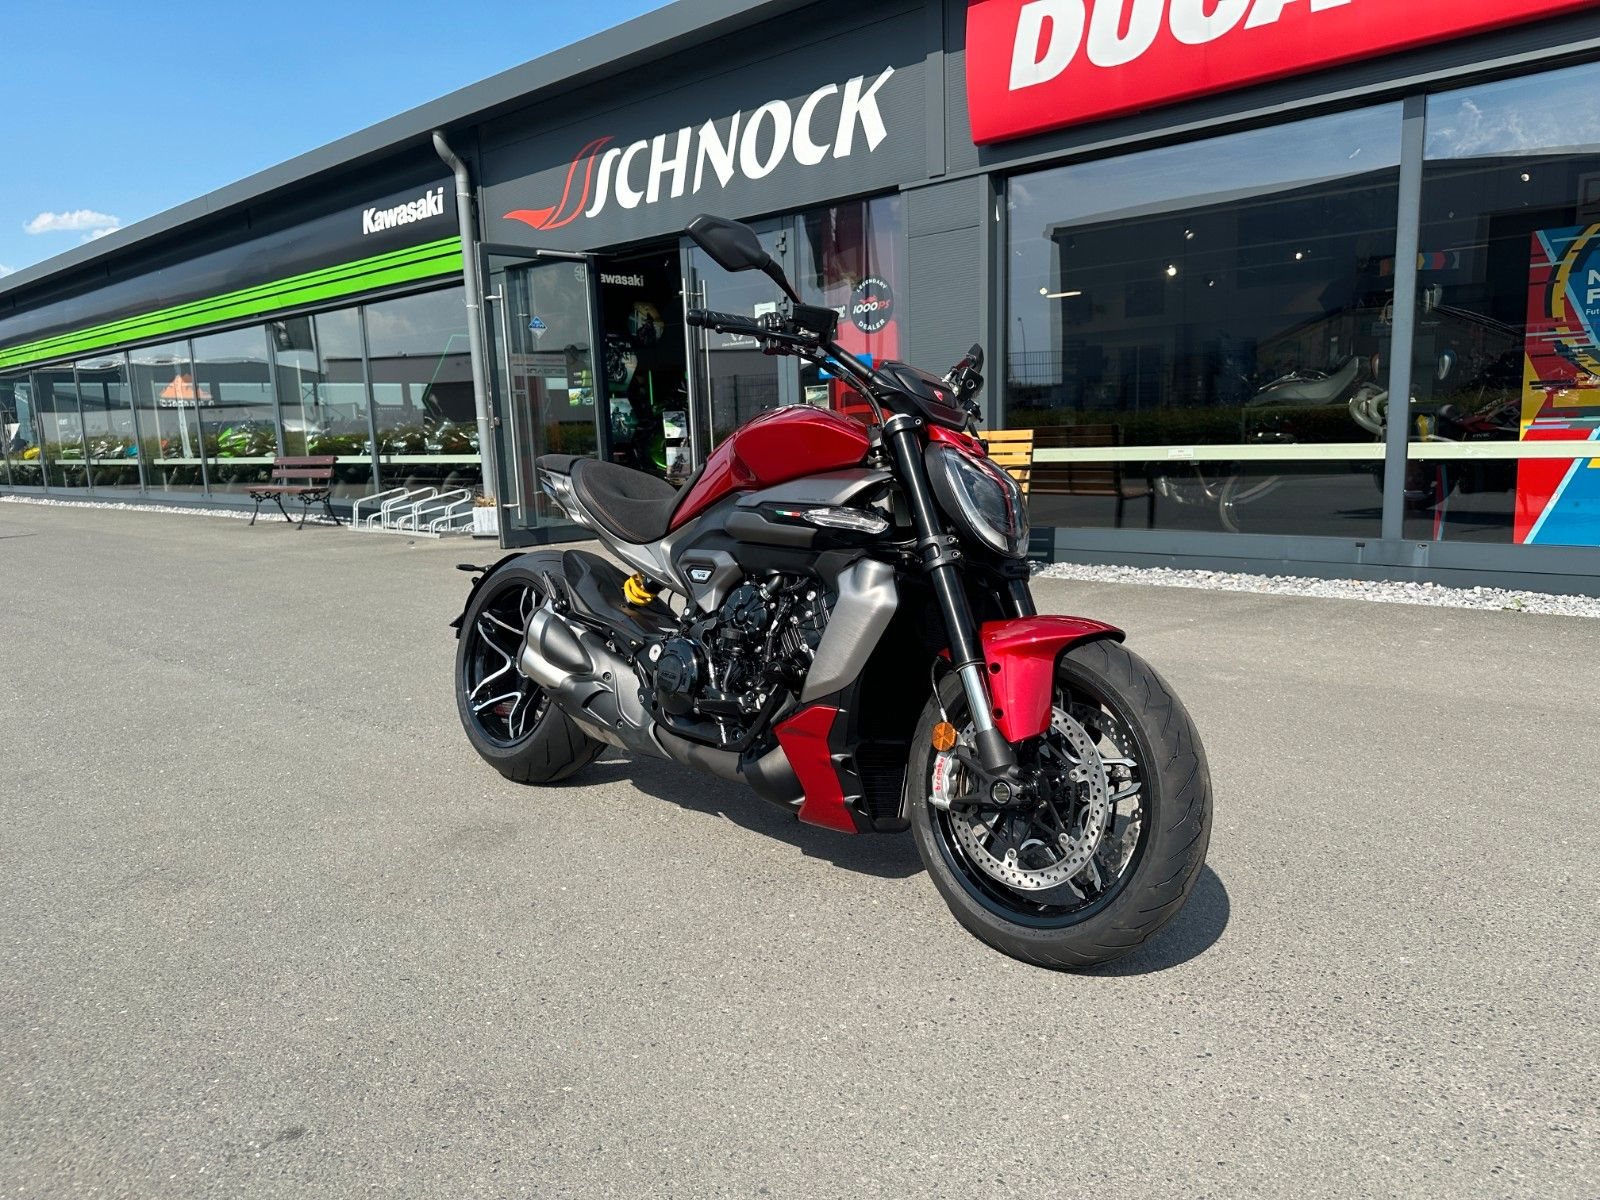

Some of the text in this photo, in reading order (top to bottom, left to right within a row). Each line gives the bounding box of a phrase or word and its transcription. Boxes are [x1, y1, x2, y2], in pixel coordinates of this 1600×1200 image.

[1009, 0, 1352, 91] DUC
[585, 66, 895, 218] SCHNOCK
[363, 187, 444, 235] Kawasaki
[857, 278, 887, 292] LEGENDARY
[853, 300, 890, 314] 1000PS
[859, 319, 885, 330] DEALER
[935, 757, 944, 791] brembo
